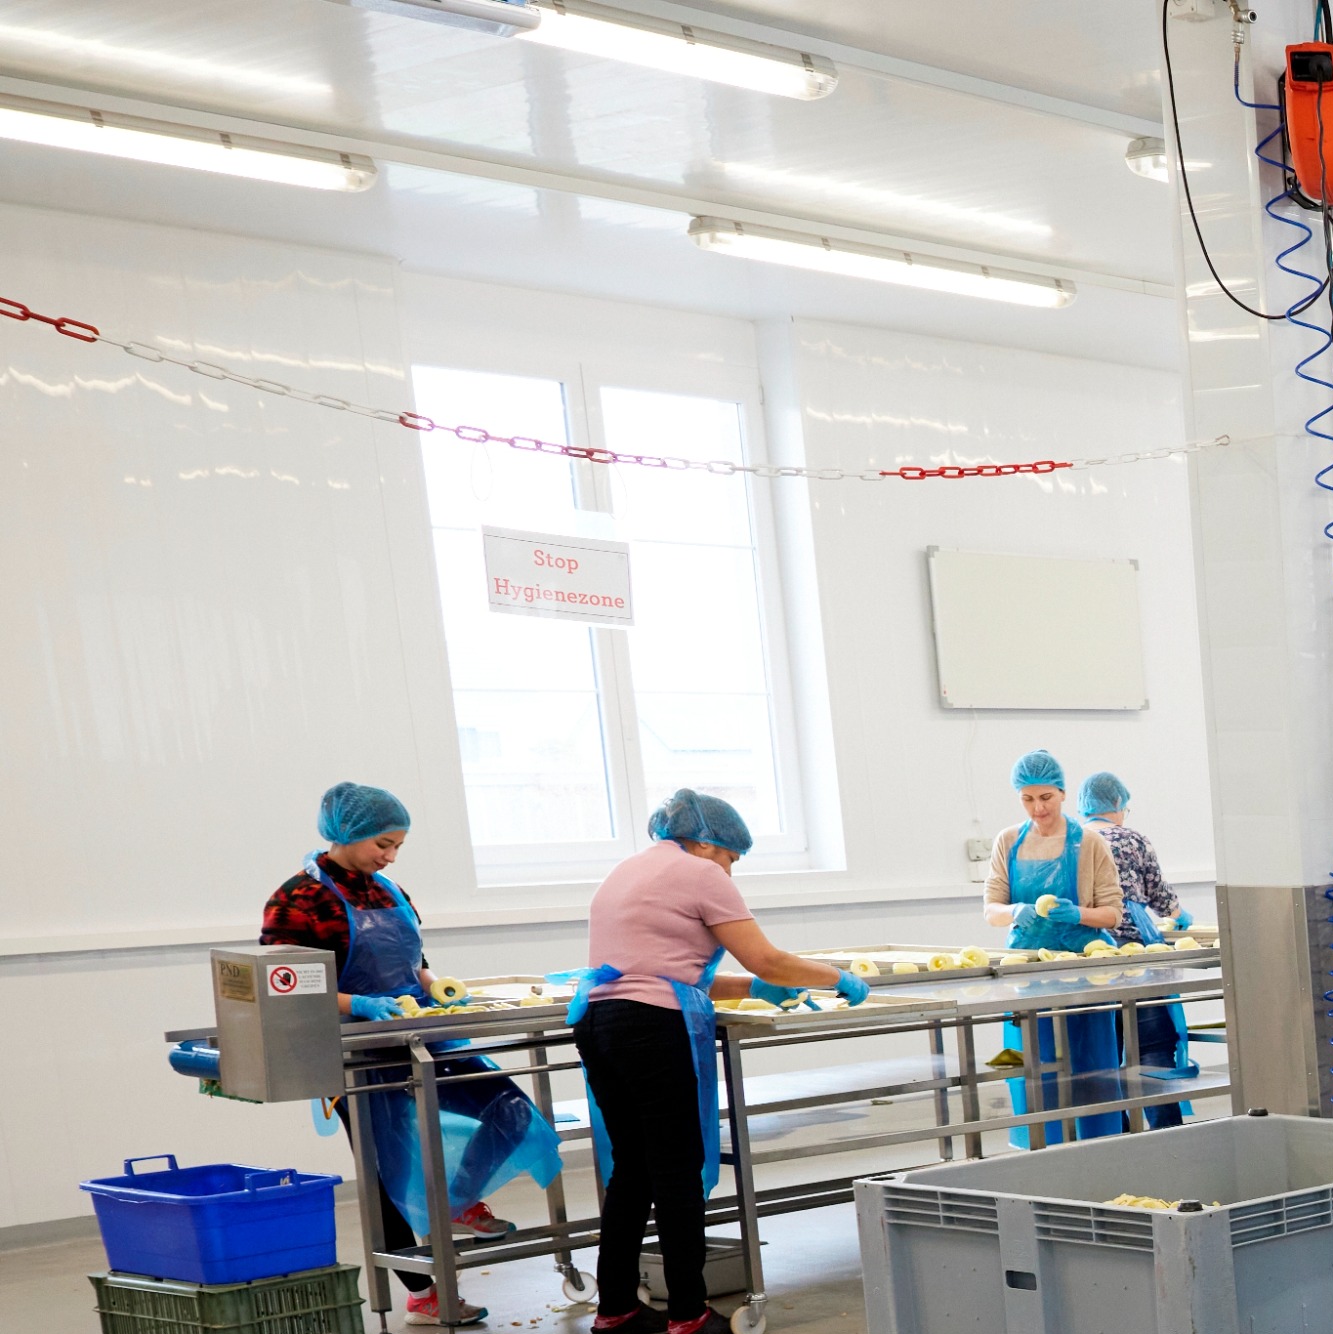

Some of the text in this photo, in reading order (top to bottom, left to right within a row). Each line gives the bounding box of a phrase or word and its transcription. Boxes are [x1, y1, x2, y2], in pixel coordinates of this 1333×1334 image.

[533, 549, 579, 574] Stop
[493, 577, 625, 609] Hygienezone
[220, 962, 240, 978] PND
